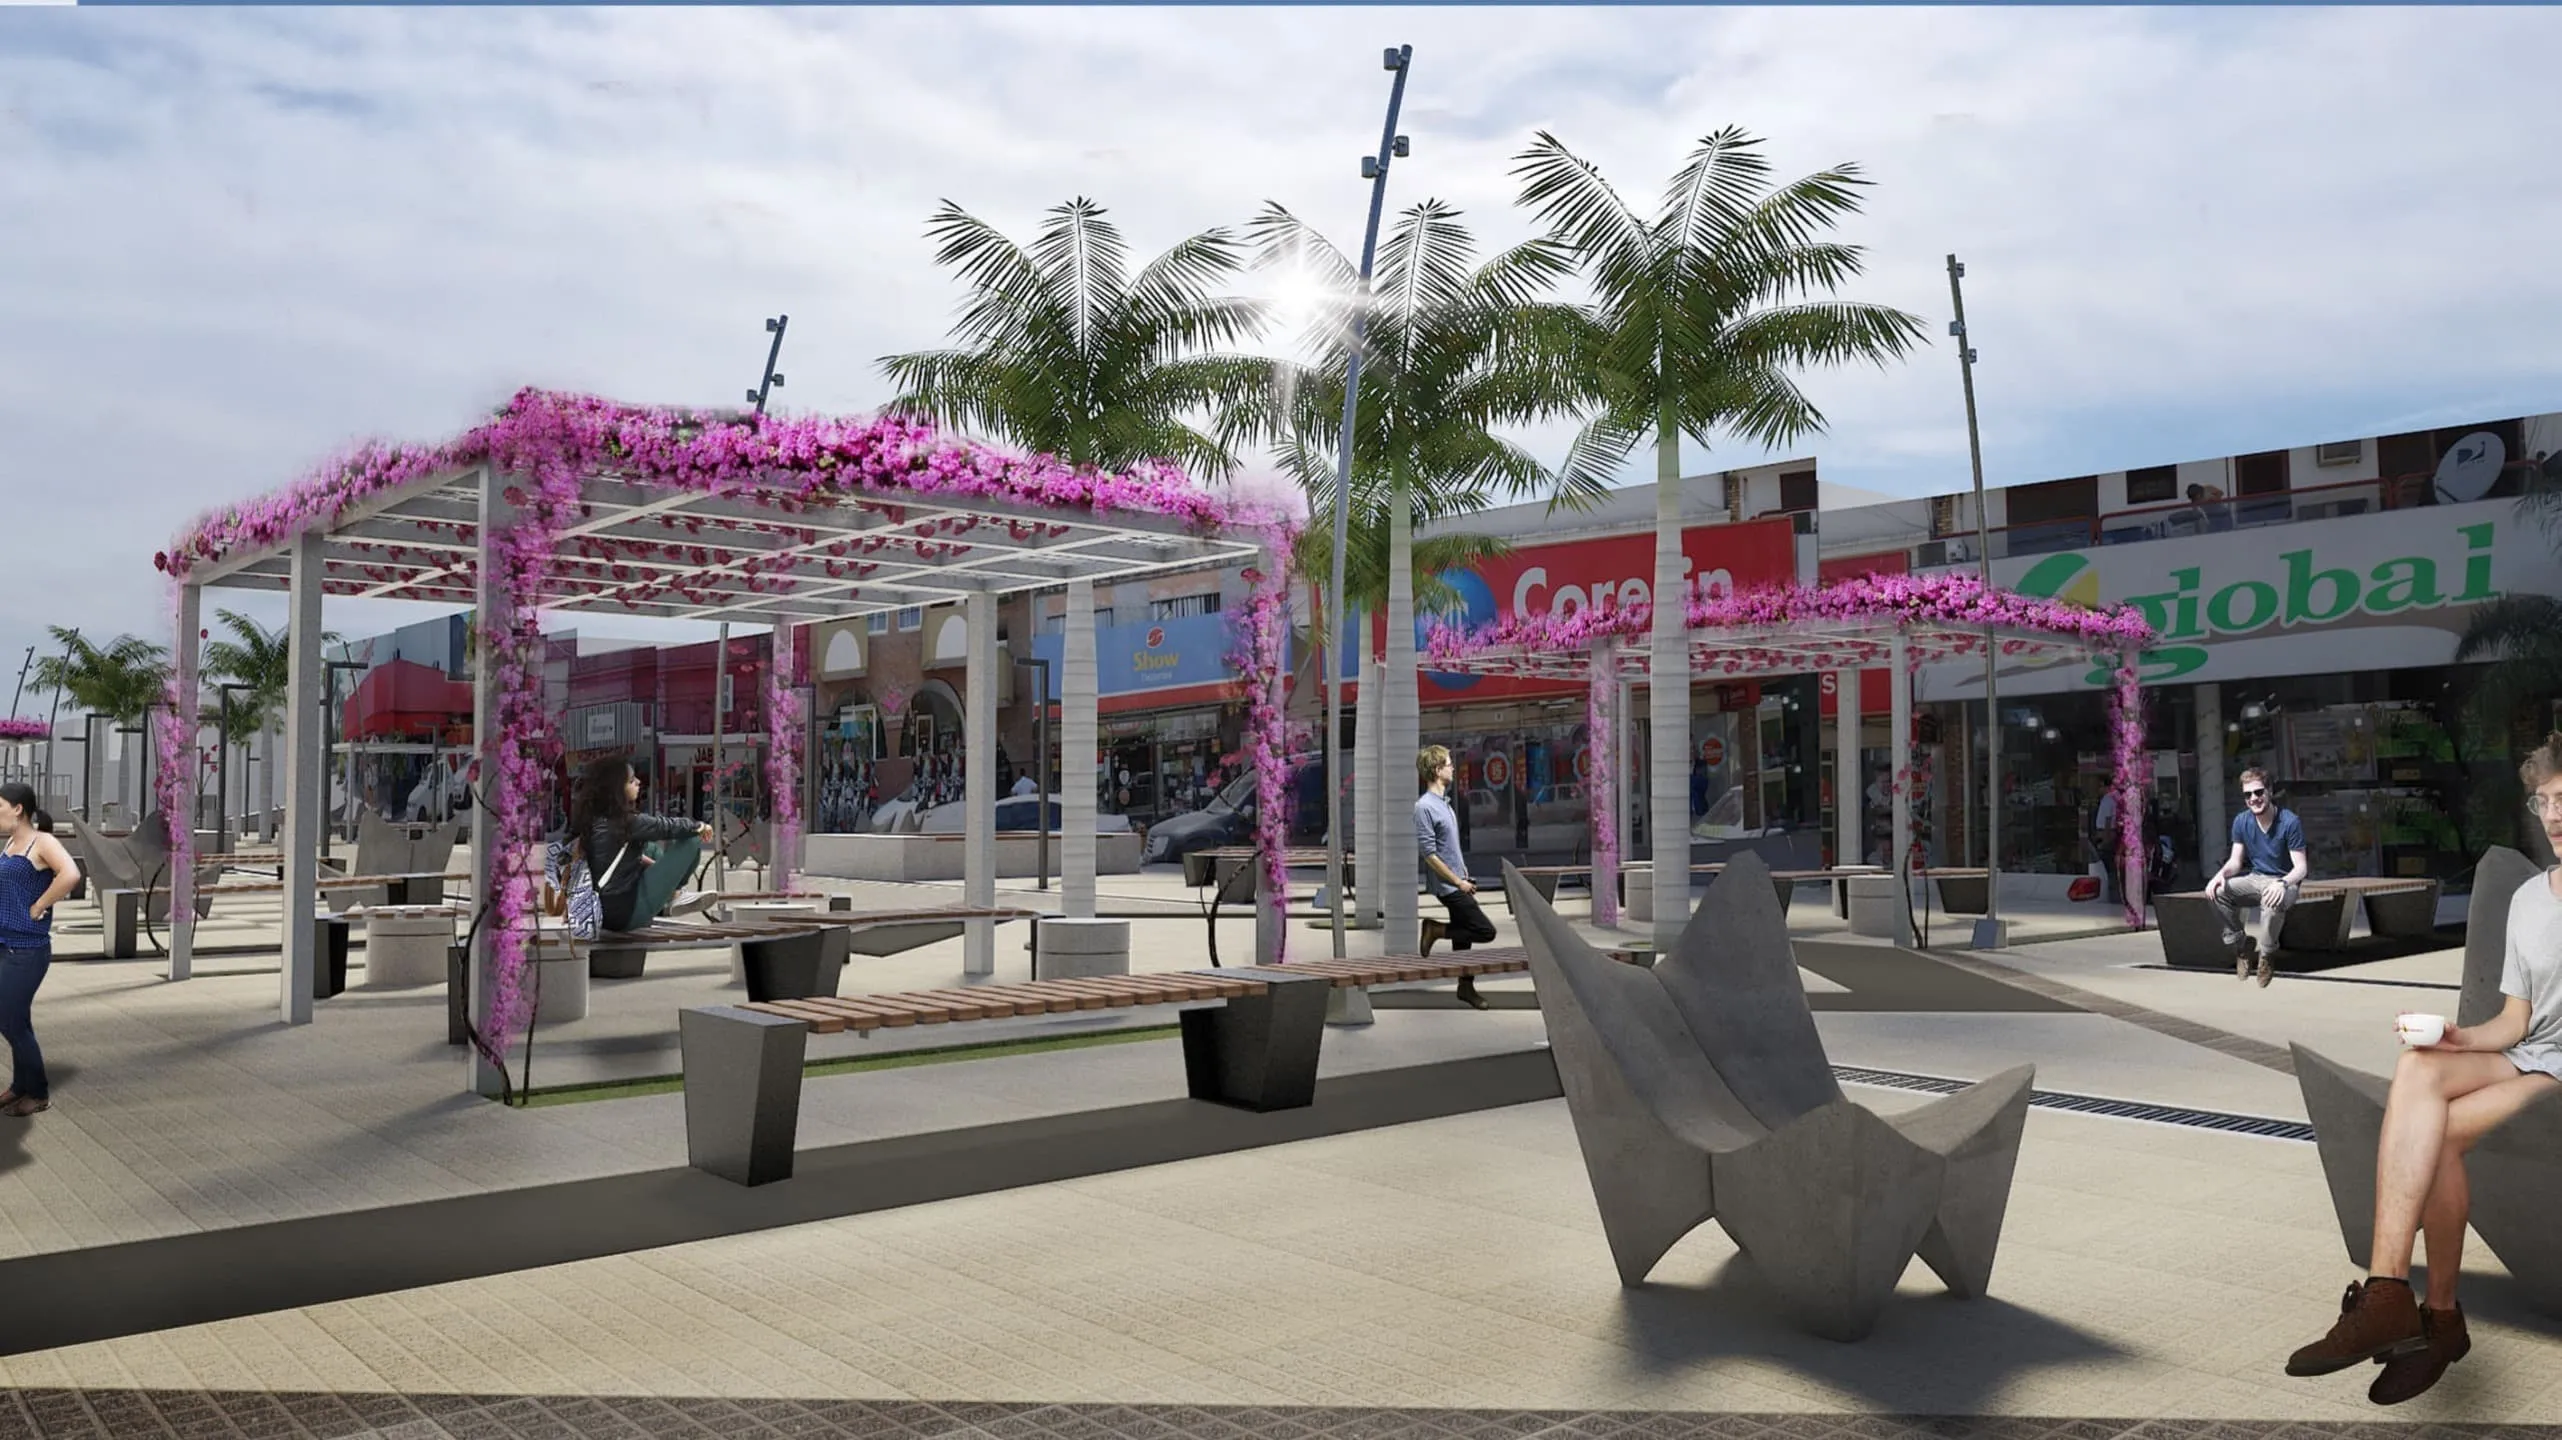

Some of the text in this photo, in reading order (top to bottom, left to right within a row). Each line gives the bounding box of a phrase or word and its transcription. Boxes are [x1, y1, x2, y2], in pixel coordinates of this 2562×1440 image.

[1512, 556, 1734, 624] Corein
[1133, 650, 1179, 672] Show
[695, 746, 726, 764] JABR
